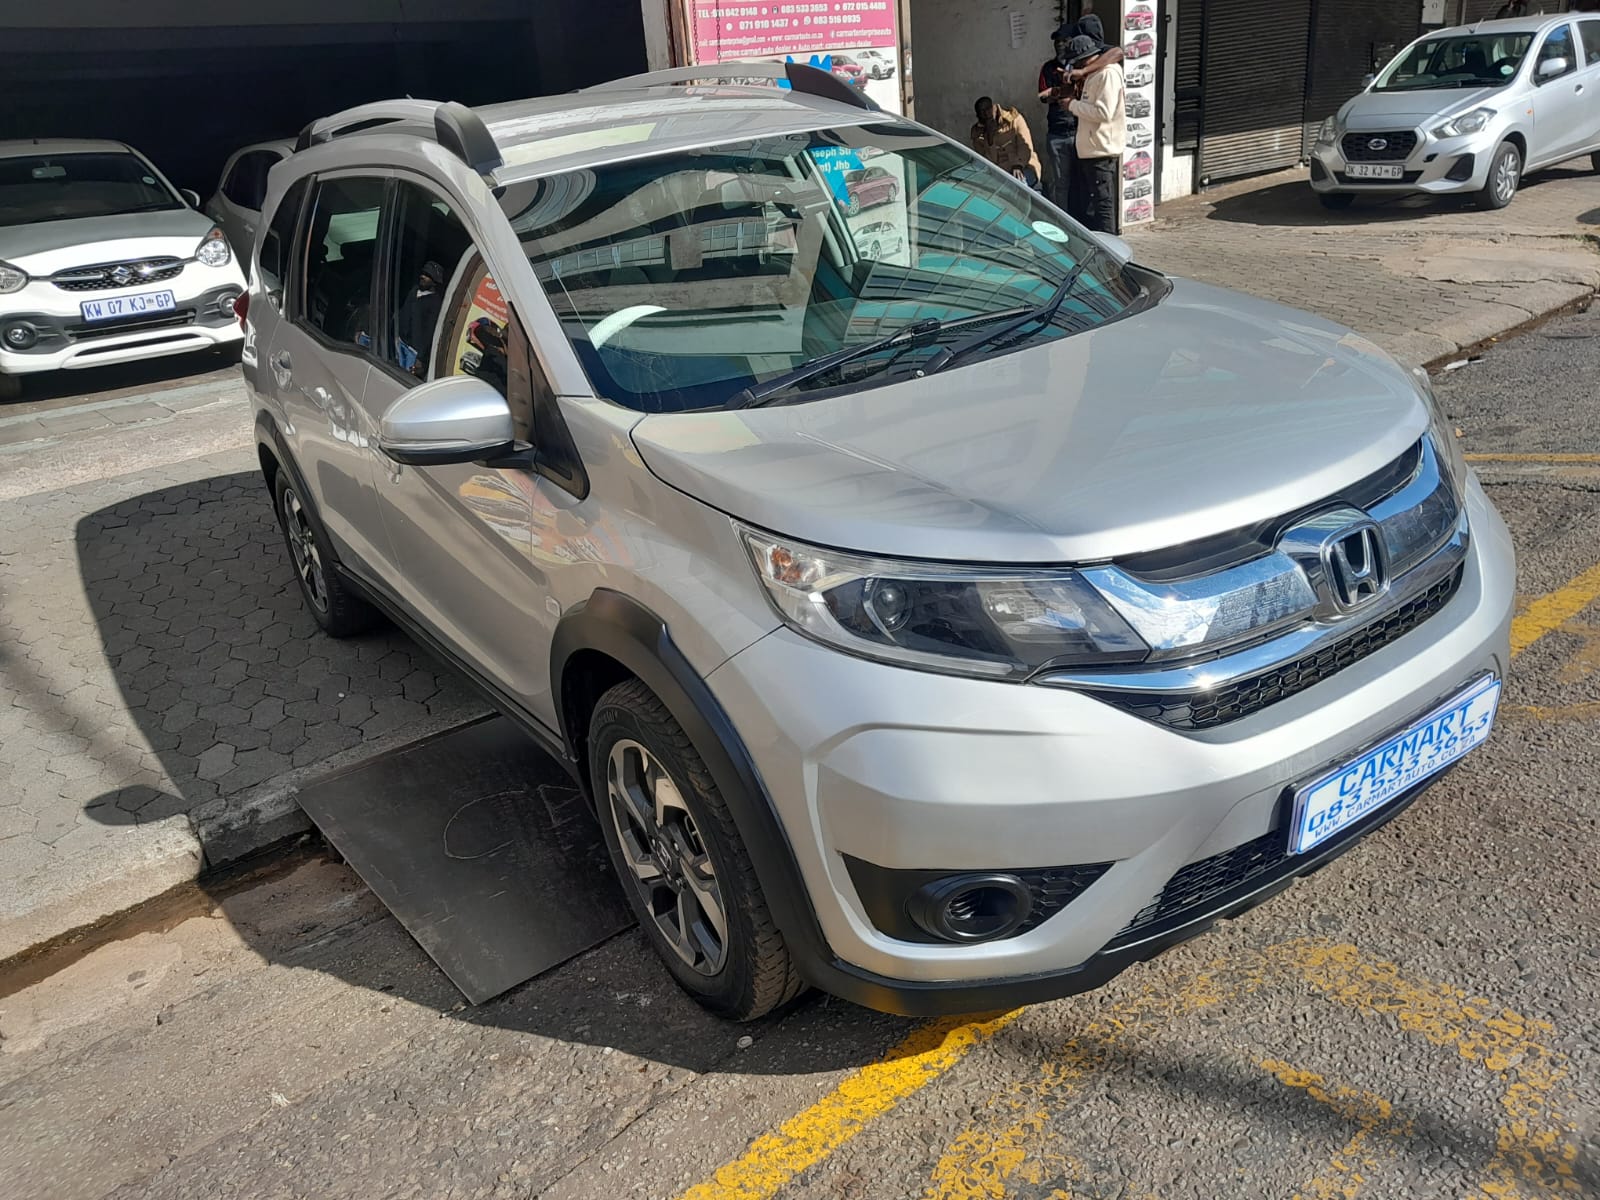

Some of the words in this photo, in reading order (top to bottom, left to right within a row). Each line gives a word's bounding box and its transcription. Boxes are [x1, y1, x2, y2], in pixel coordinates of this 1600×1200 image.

[834, 160, 850, 171] Jhb
[85, 303, 102, 318] KW
[107, 300, 122, 314] 07
[130, 297, 146, 311] KJ
[156, 293, 170, 307] GP
[1308, 786, 1362, 833] 083
[1370, 752, 1421, 795] 533
[1428, 710, 1490, 759] 3653
[1339, 700, 1474, 797] CARMART
